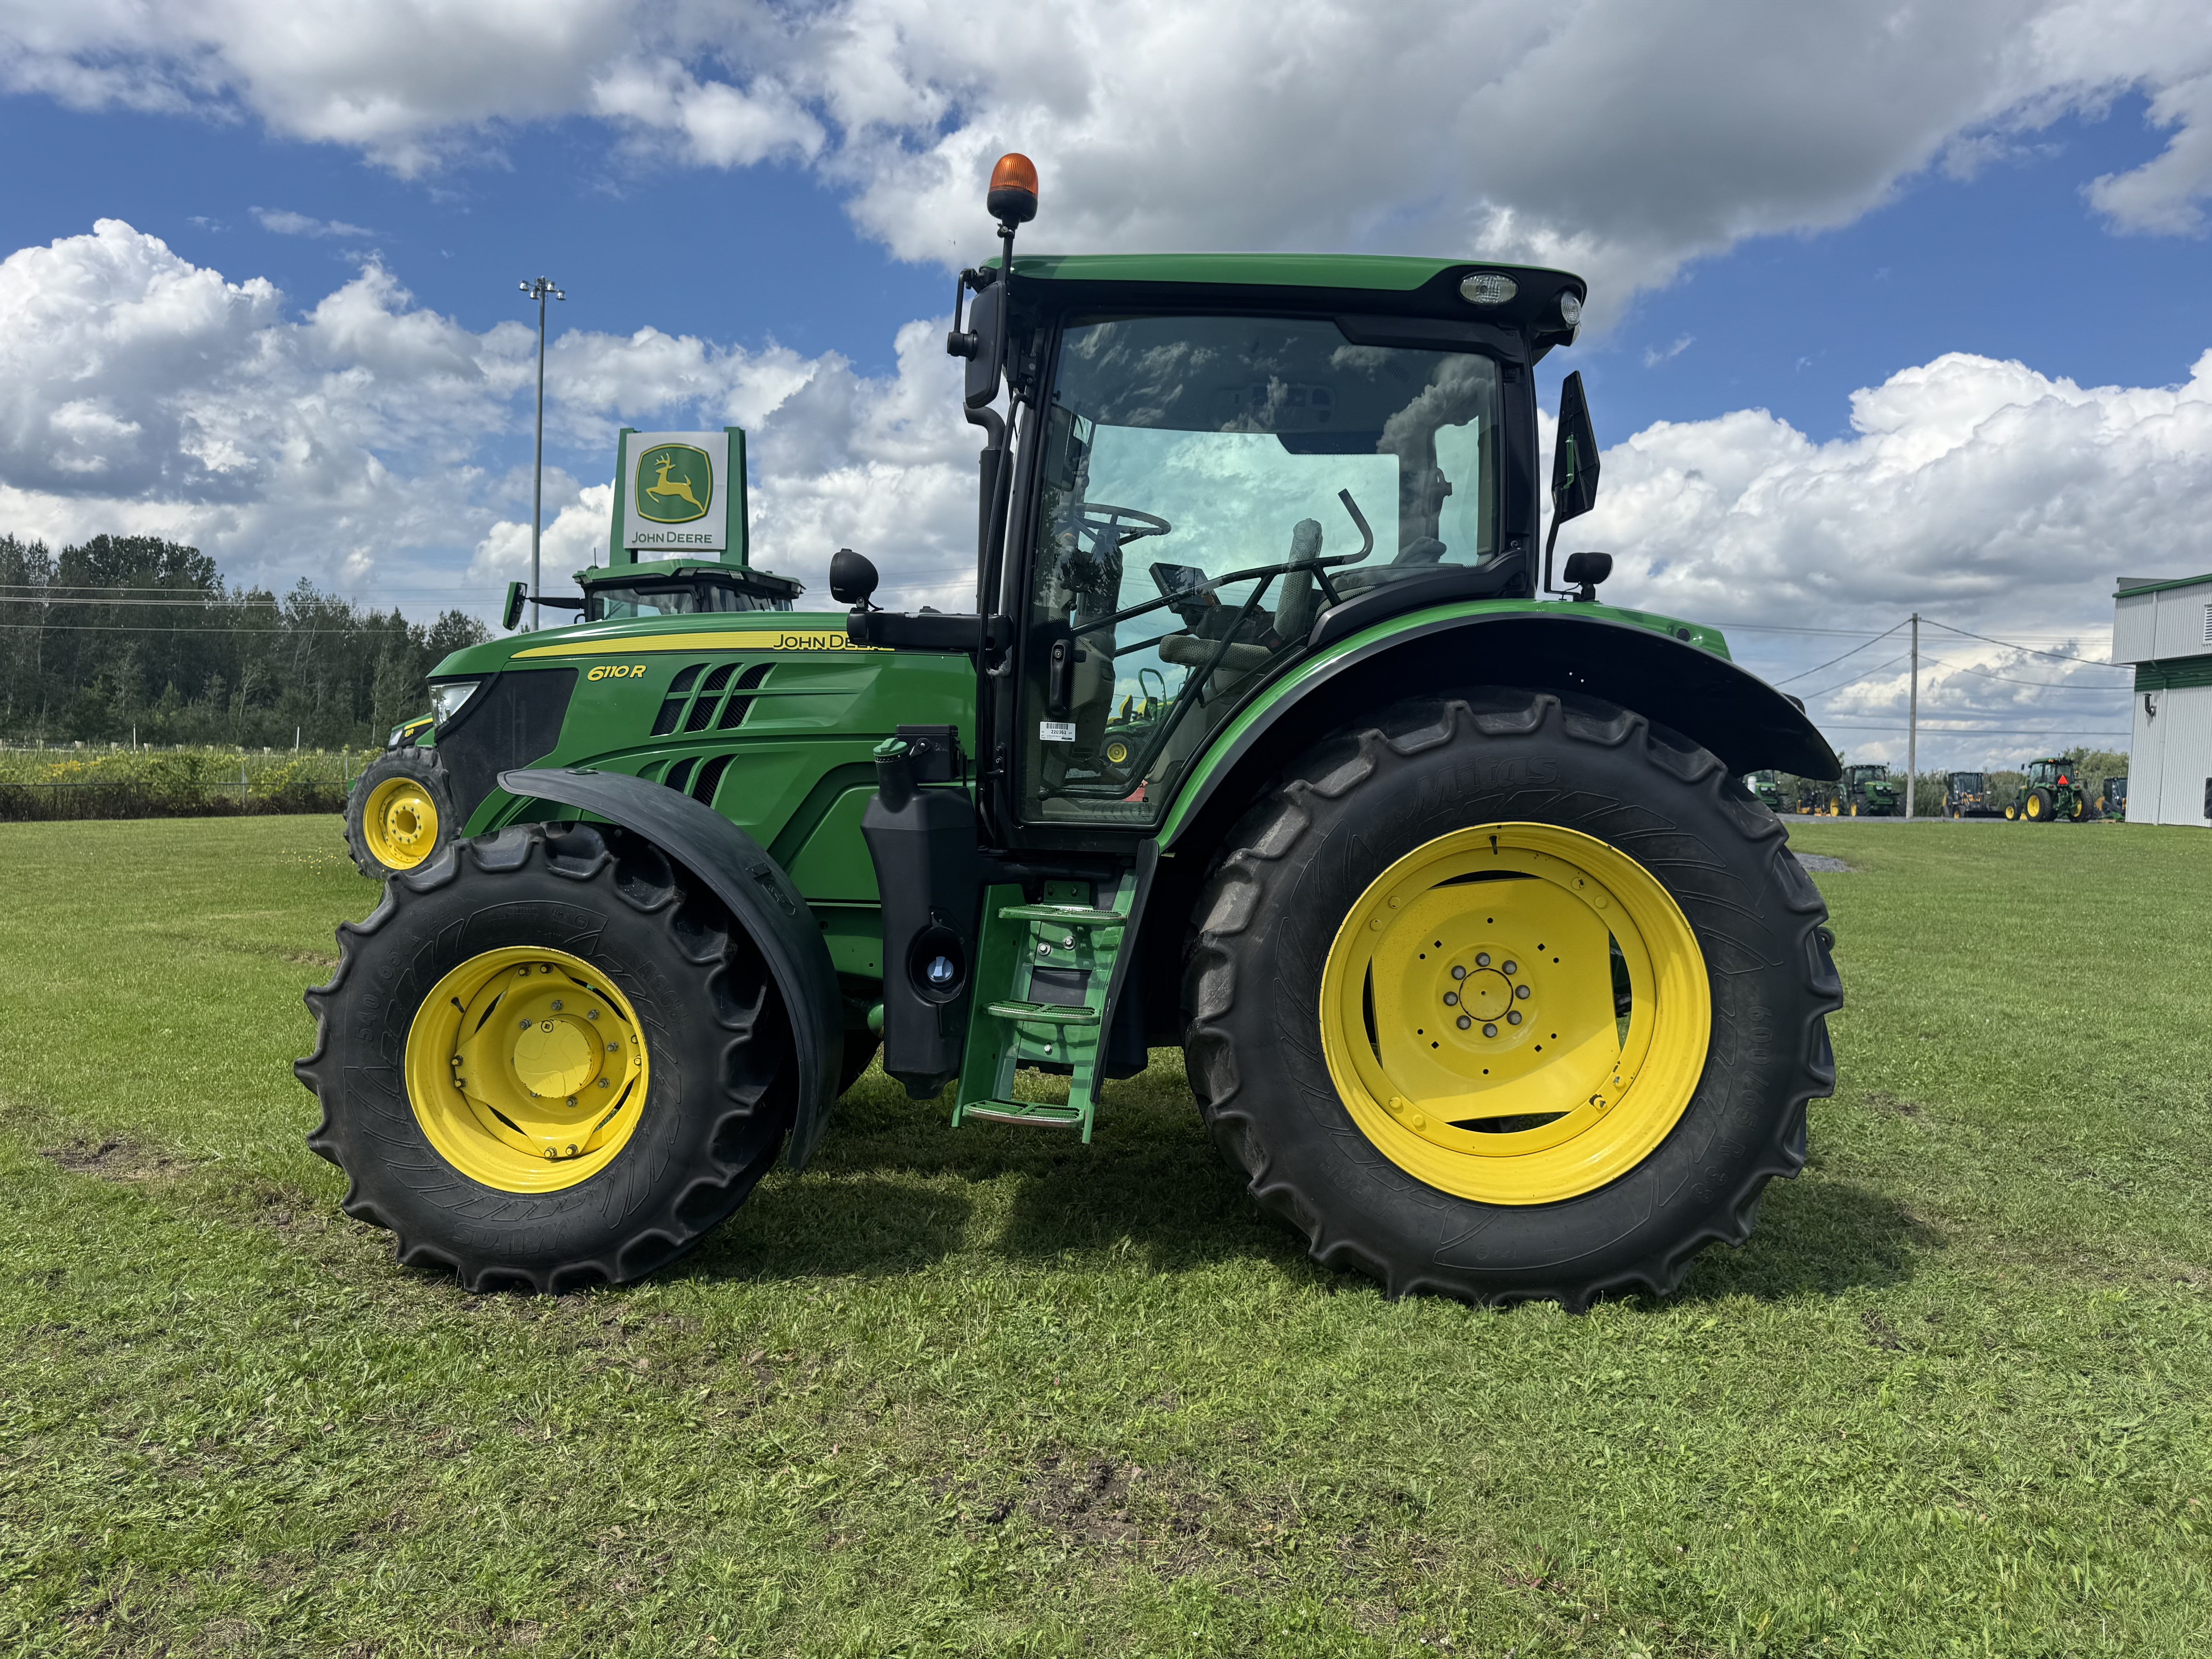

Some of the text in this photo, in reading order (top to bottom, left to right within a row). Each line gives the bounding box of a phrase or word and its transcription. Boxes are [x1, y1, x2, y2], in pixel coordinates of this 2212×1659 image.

[632, 532, 712, 543] JOHN DEERE
[773, 634, 825, 648] JOHN
[1407, 755, 1560, 819] Mitas
